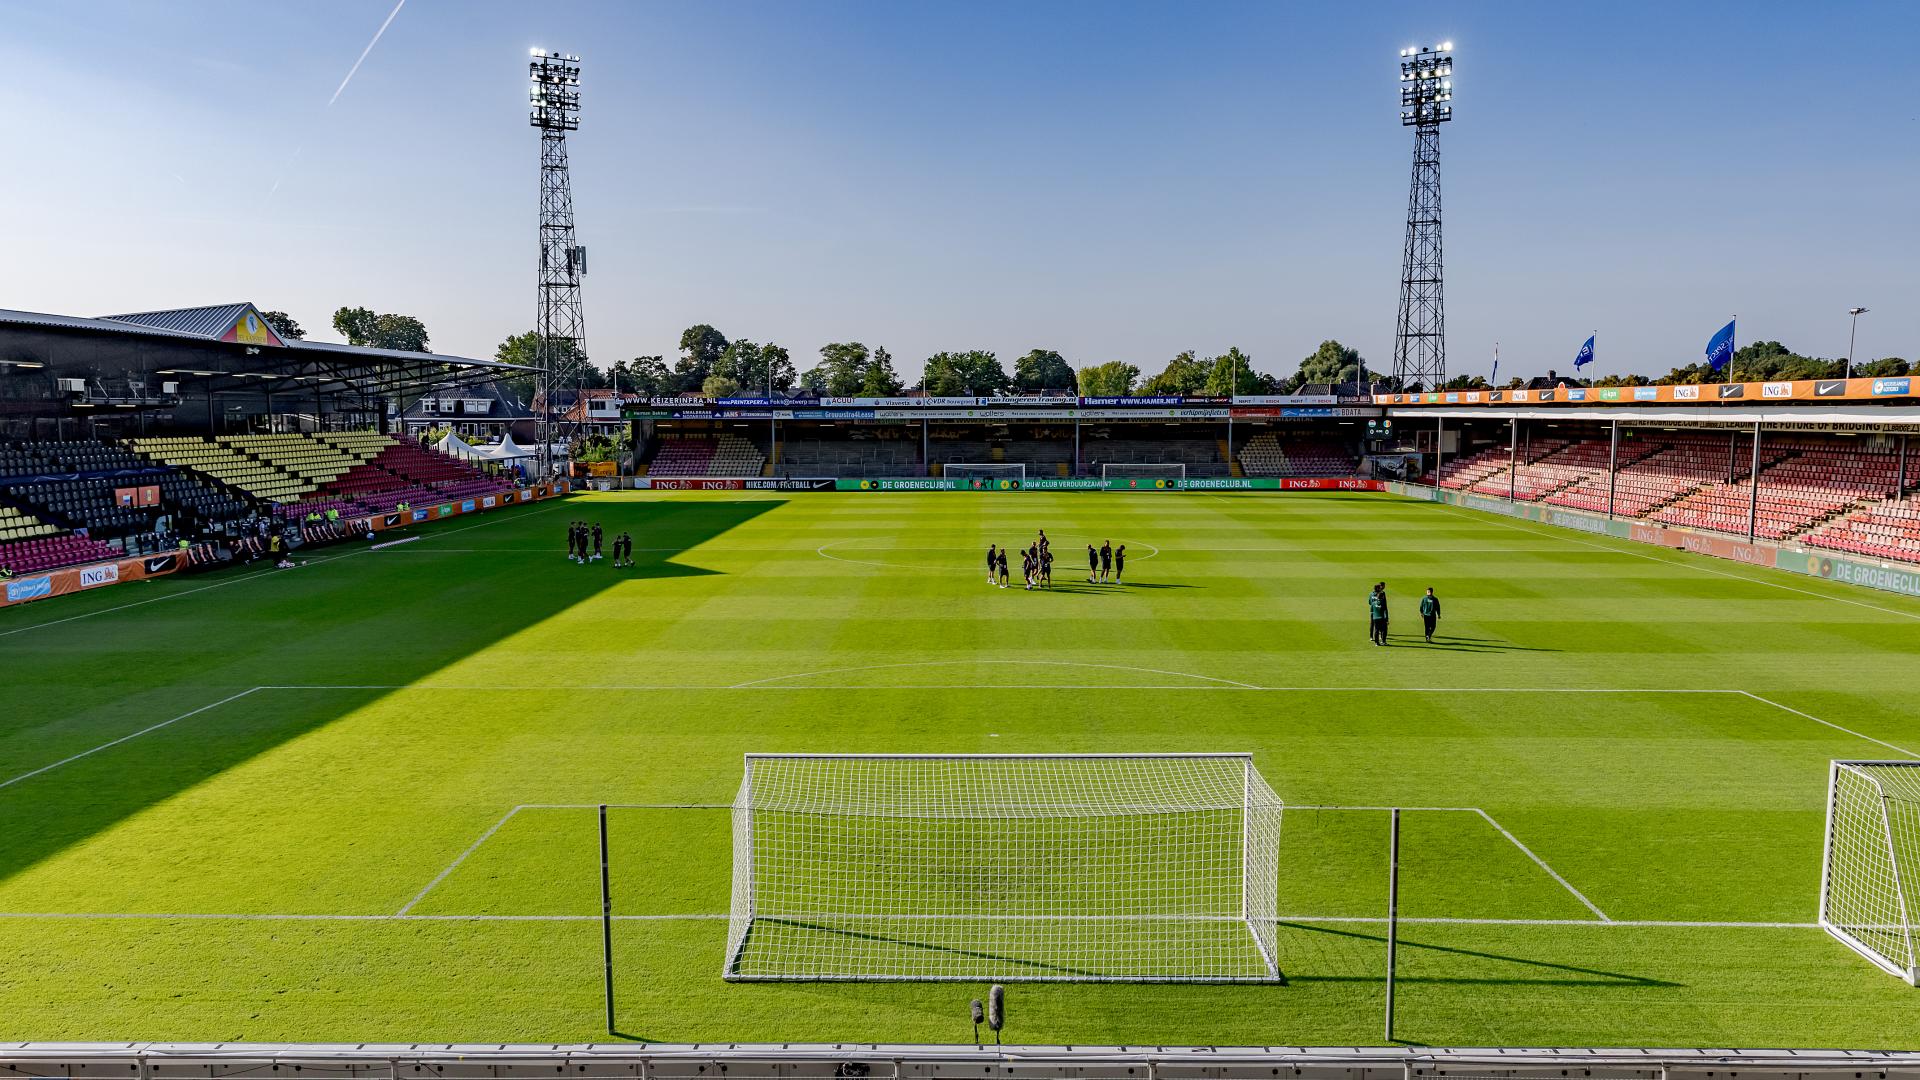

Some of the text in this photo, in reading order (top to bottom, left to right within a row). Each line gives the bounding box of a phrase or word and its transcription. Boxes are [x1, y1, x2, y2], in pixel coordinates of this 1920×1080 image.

[1675, 389, 1689, 397] ING
[1764, 386, 1779, 396] ING
[1084, 397, 1119, 405] Hamer
[1832, 422, 1880, 430] BRIDGING
[656, 481, 677, 489] ING
[702, 481, 723, 489] ING
[882, 481, 892, 489] DE
[1178, 480, 1252, 488] DE GROENECLUB.NL
[1289, 480, 1308, 488] ING
[1339, 480, 1356, 488] ING
[1637, 528, 1654, 541] ING
[1682, 536, 1701, 551] ING
[1733, 545, 1753, 561] ING
[1837, 563, 1852, 580] DE
[82, 571, 103, 585] ING
